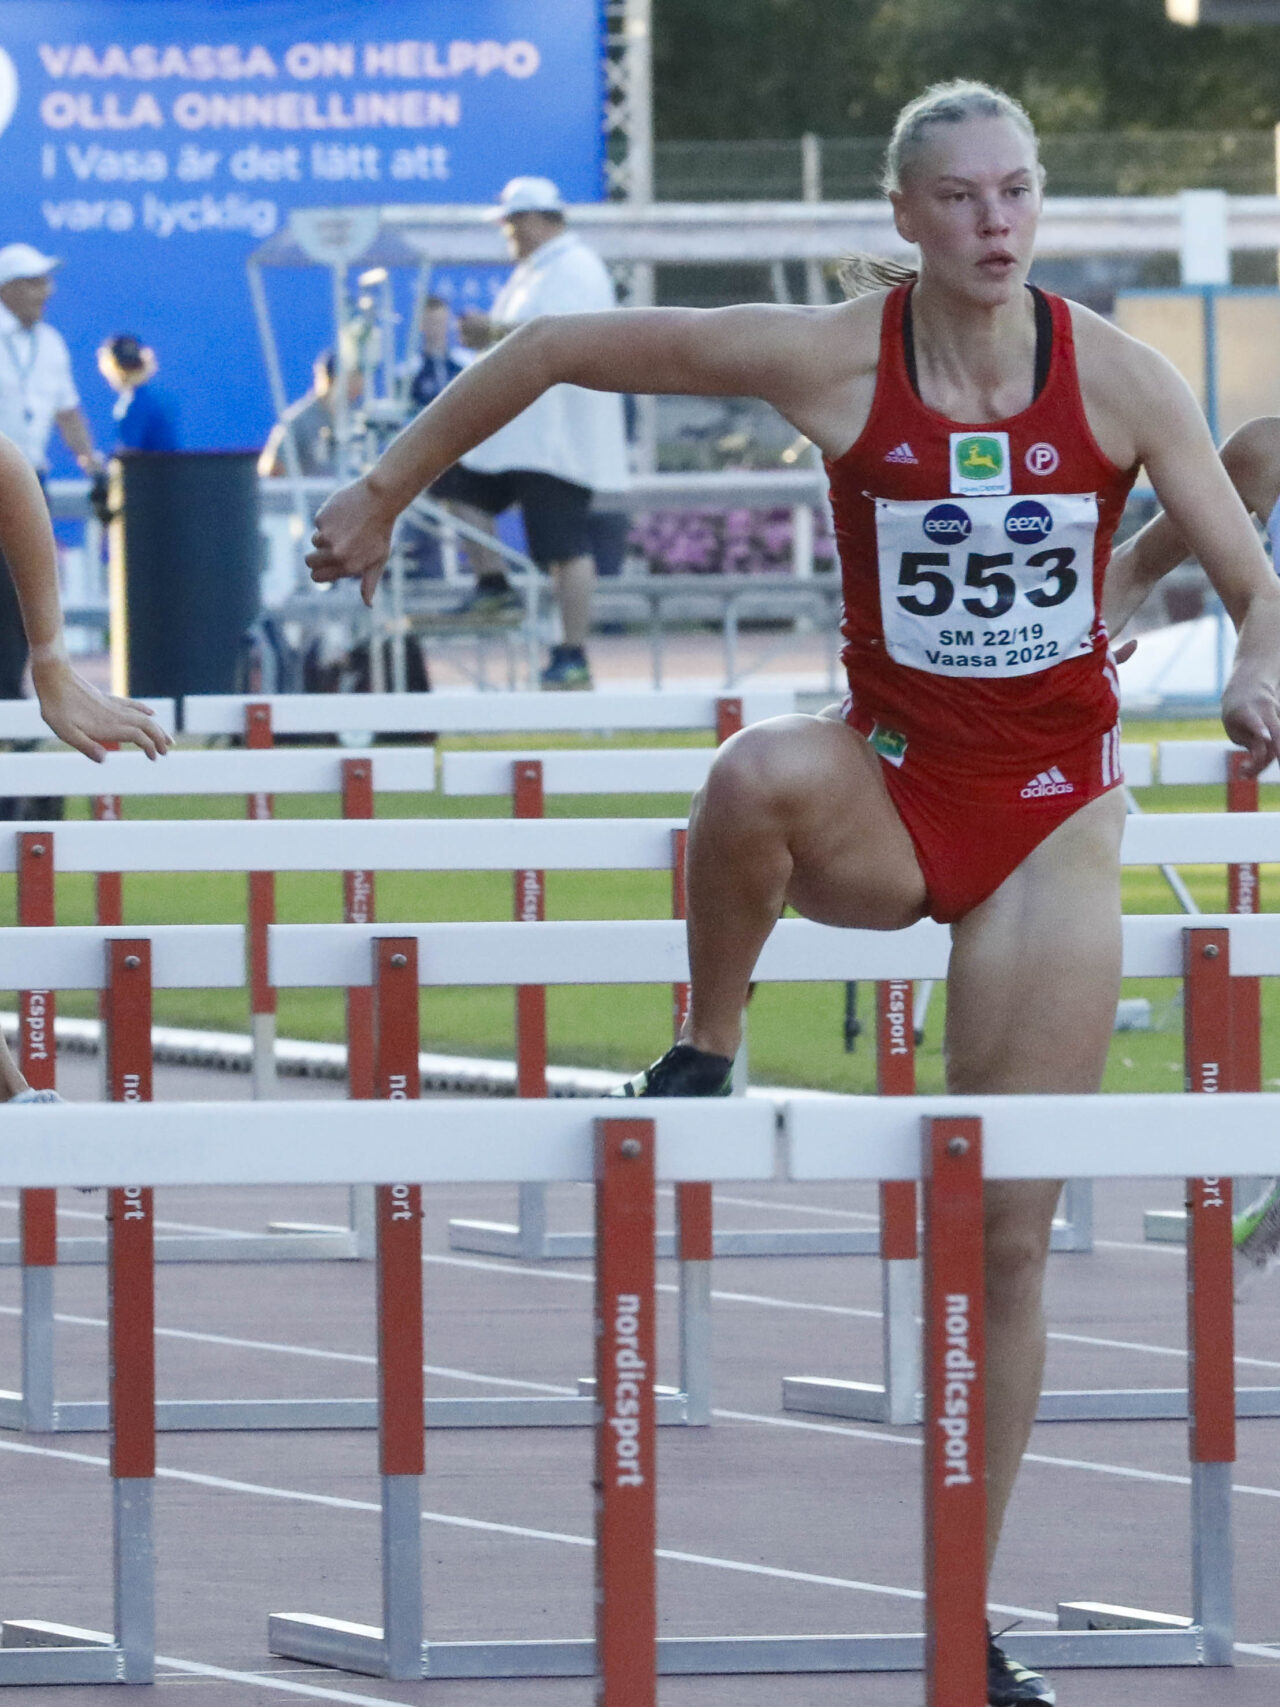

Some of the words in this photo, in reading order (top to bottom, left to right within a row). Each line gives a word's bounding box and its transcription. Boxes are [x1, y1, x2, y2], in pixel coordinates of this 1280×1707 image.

[38, 43, 277, 80] VAASASSA
[285, 42, 355, 79] ON
[364, 40, 540, 78] HELPPO
[40, 92, 163, 130] OLLA
[173, 92, 460, 129] ONNELLINEN
[66, 142, 168, 182] Vasa
[176, 142, 219, 182] är
[230, 142, 300, 182] det
[311, 140, 380, 181] lätt
[390, 144, 450, 181] att
[42, 199, 134, 231] vara
[143, 193, 277, 237] lycklig
[884, 455, 919, 465] adidas
[925, 518, 971, 536] eezy
[1005, 515, 1053, 534] eezy
[896, 547, 1079, 619] 553
[925, 650, 997, 667] Vaasa
[1006, 641, 1059, 666] 2022
[939, 630, 974, 646] SM
[983, 624, 1043, 646] 22/19
[1020, 782, 1074, 799] adidas
[886, 980, 909, 1054] icsport
[609, 1293, 647, 1487] nordicsport
[937, 1293, 975, 1487] nordicsport
